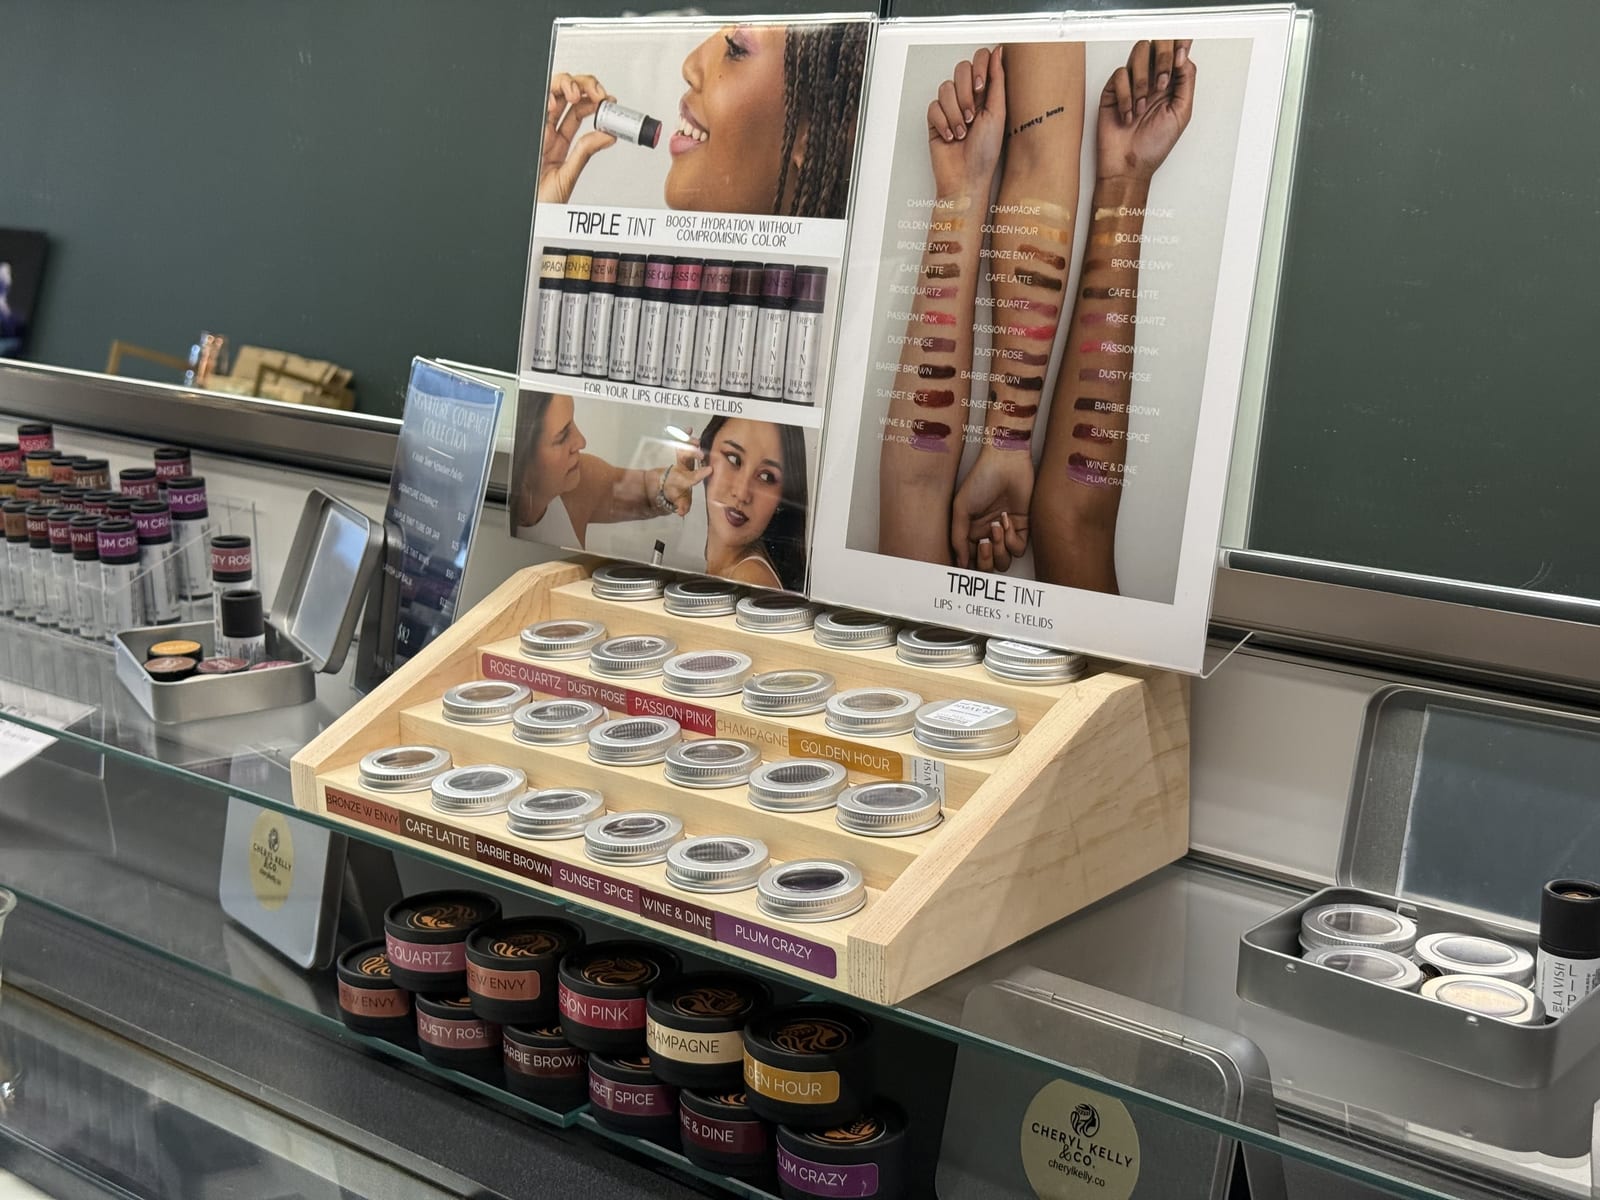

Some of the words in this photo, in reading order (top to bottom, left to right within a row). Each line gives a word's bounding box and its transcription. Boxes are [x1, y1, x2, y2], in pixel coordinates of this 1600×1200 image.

[907, 199, 955, 209] CHAMPAGNE
[989, 205, 1041, 216] CHAMPAGNE
[1119, 207, 1176, 218] CHAMPAGNE
[567, 211, 621, 236] TRIPLE
[627, 216, 656, 237] TINT
[665, 215, 697, 229] BOOST
[701, 217, 755, 231] HYDRATION
[759, 220, 803, 235] WITHOUT
[897, 220, 928, 230] GOLDEN
[929, 221, 952, 231] HOUR
[980, 224, 1013, 235] GOLDEN
[1014, 226, 1039, 235] HOUR
[676, 229, 748, 245] COMPROMISING
[751, 233, 787, 247] COLOR
[1115, 233, 1150, 243] GOLDEN
[1152, 235, 1179, 245] HOUR
[897, 240, 927, 251] BRONZE
[928, 242, 950, 252] ENVY
[979, 249, 1012, 259] BRONZE
[1013, 251, 1035, 260] ENVY
[899, 264, 919, 273] CAFE
[920, 266, 945, 275] LATTE
[1111, 259, 1145, 269] BRONZE
[1148, 260, 1174, 271] ENVY
[985, 273, 1006, 283] CAFE
[1007, 274, 1033, 285] LATTE
[888, 284, 909, 295] ROSE
[910, 286, 942, 297] QUARTZ
[1108, 288, 1131, 297] CAFE
[1132, 289, 1160, 299] LATTE
[975, 297, 995, 307] ROSE
[997, 299, 1030, 310] QUARTZ
[886, 311, 919, 322] PASSION
[920, 314, 939, 324] PINK
[1106, 313, 1128, 323] ROSE
[1130, 315, 1167, 326] QUARTZ
[972, 323, 1007, 335] PASSION
[1007, 326, 1027, 336] PINK
[887, 335, 913, 345] DUSTY
[913, 338, 934, 348] ROSE
[974, 347, 1001, 357] DUSTY
[1001, 350, 1024, 360] ROSE
[1101, 343, 1137, 354] PASSION
[1138, 345, 1159, 356] PINK
[875, 362, 902, 372] BARBIE
[902, 365, 933, 376] BROWN
[1098, 369, 1127, 380] DUSTY
[1128, 372, 1152, 382] ROSE
[960, 370, 989, 381] BARBIE
[989, 374, 1020, 385] BROWN
[584, 382, 601, 394] FOR
[606, 385, 628, 399] YOUR
[694, 396, 700, 408] &
[704, 397, 743, 414] EYELIDS
[876, 389, 908, 400] SUNSET
[908, 391, 929, 402] SPICE
[960, 398, 993, 410] SUNSET
[993, 402, 1016, 412] SPICE
[1094, 401, 1125, 413] BARBIE
[1126, 404, 1160, 416] BROWN
[879, 417, 899, 427] WINE
[899, 419, 906, 428] &
[906, 420, 925, 430] DINE
[962, 424, 983, 435] WINE
[984, 426, 990, 435] &
[991, 427, 1011, 438] DINE
[1090, 428, 1125, 440] SUNSET
[1126, 431, 1150, 443] SPICE
[877, 433, 896, 442] PLUM
[895, 435, 919, 445] CRAZY
[962, 435, 981, 444] PLUM
[981, 436, 1005, 446] CRAZY
[1086, 460, 1108, 471] WINE
[1109, 463, 1116, 472] &
[1117, 463, 1138, 474] DINE
[1086, 475, 1107, 484] PLUM
[1107, 477, 1131, 487] CRAZY
[947, 571, 1007, 602] TRIPLE
[1013, 585, 1046, 608] TINT
[934, 597, 953, 611] LIPS
[965, 603, 1001, 620] CHEEKS
[1014, 612, 1054, 630] EYELIDS
[489, 660, 517, 679] ROSE
[518, 667, 562, 690] QUARTZ
[567, 680, 598, 699] DUSTY
[600, 688, 626, 705] ROSE
[634, 697, 683, 721] PASSION
[685, 709, 713, 729] PINK
[716, 719, 788, 748] CHAMPAGNE
[800, 739, 851, 762] GOLDEN
[854, 752, 891, 772] HOUR
[327, 794, 362, 815] BRONZE
[362, 804, 373, 818] W
[374, 807, 399, 825] ENVY
[405, 818, 434, 838] CAFE
[435, 826, 470, 851] LATTE
[476, 841, 512, 863] BARBIE
[513, 853, 553, 878] BROWN
[559, 868, 601, 892] SUNSET
[603, 882, 634, 903] SPICE
[642, 896, 672, 917] WINE
[674, 904, 683, 920] &
[685, 909, 712, 930] DINE
[735, 924, 769, 947] PLUM
[771, 936, 813, 961] CRAZY
[394, 945, 453, 966] QUARTZ
[489, 977, 526, 991] ENVY
[1552, 962, 1566, 1006] LAVISH
[361, 996, 396, 1008] ENVY
[591, 1005, 629, 1020] PINK
[420, 1018, 453, 1039] DUSTY
[774, 1078, 822, 1096] HOUR
[615, 1090, 655, 1106] SPICE
[691, 1121, 699, 1135] &
[701, 1125, 735, 1143] DINE
[1031, 1122, 1084, 1151] CHERYL
[1089, 1143, 1133, 1168] KELLY
[799, 1167, 848, 1187] CRAZY
[1048, 1158, 1105, 1187] cherylkelly.co
